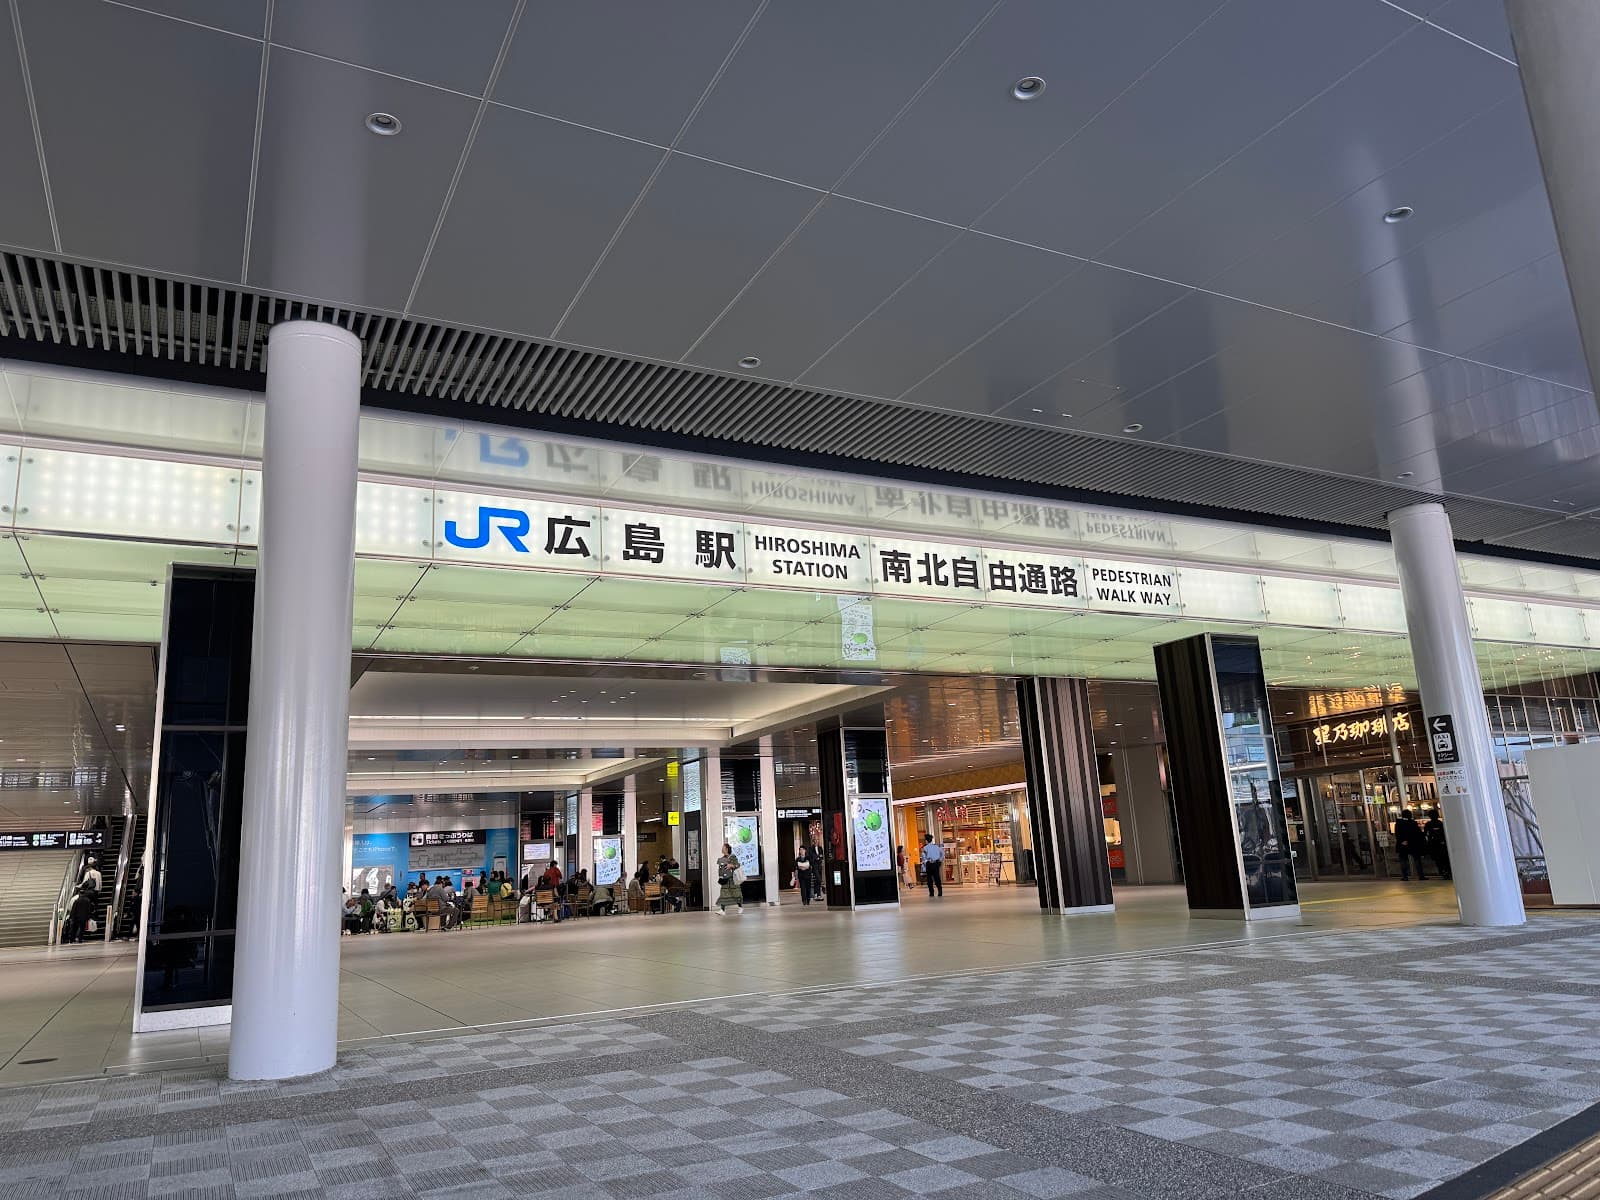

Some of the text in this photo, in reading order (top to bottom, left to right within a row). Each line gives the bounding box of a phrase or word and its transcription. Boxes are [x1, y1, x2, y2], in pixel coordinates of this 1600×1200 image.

[445, 507, 530, 552] JR
[755, 535, 861, 560] HIROSHIMA
[772, 559, 849, 580] STATION
[880, 549, 1078, 598] 南北自由通路
[1092, 567, 1173, 588] PEDESTRIAN
[1096, 587, 1172, 606] WALK WAY
